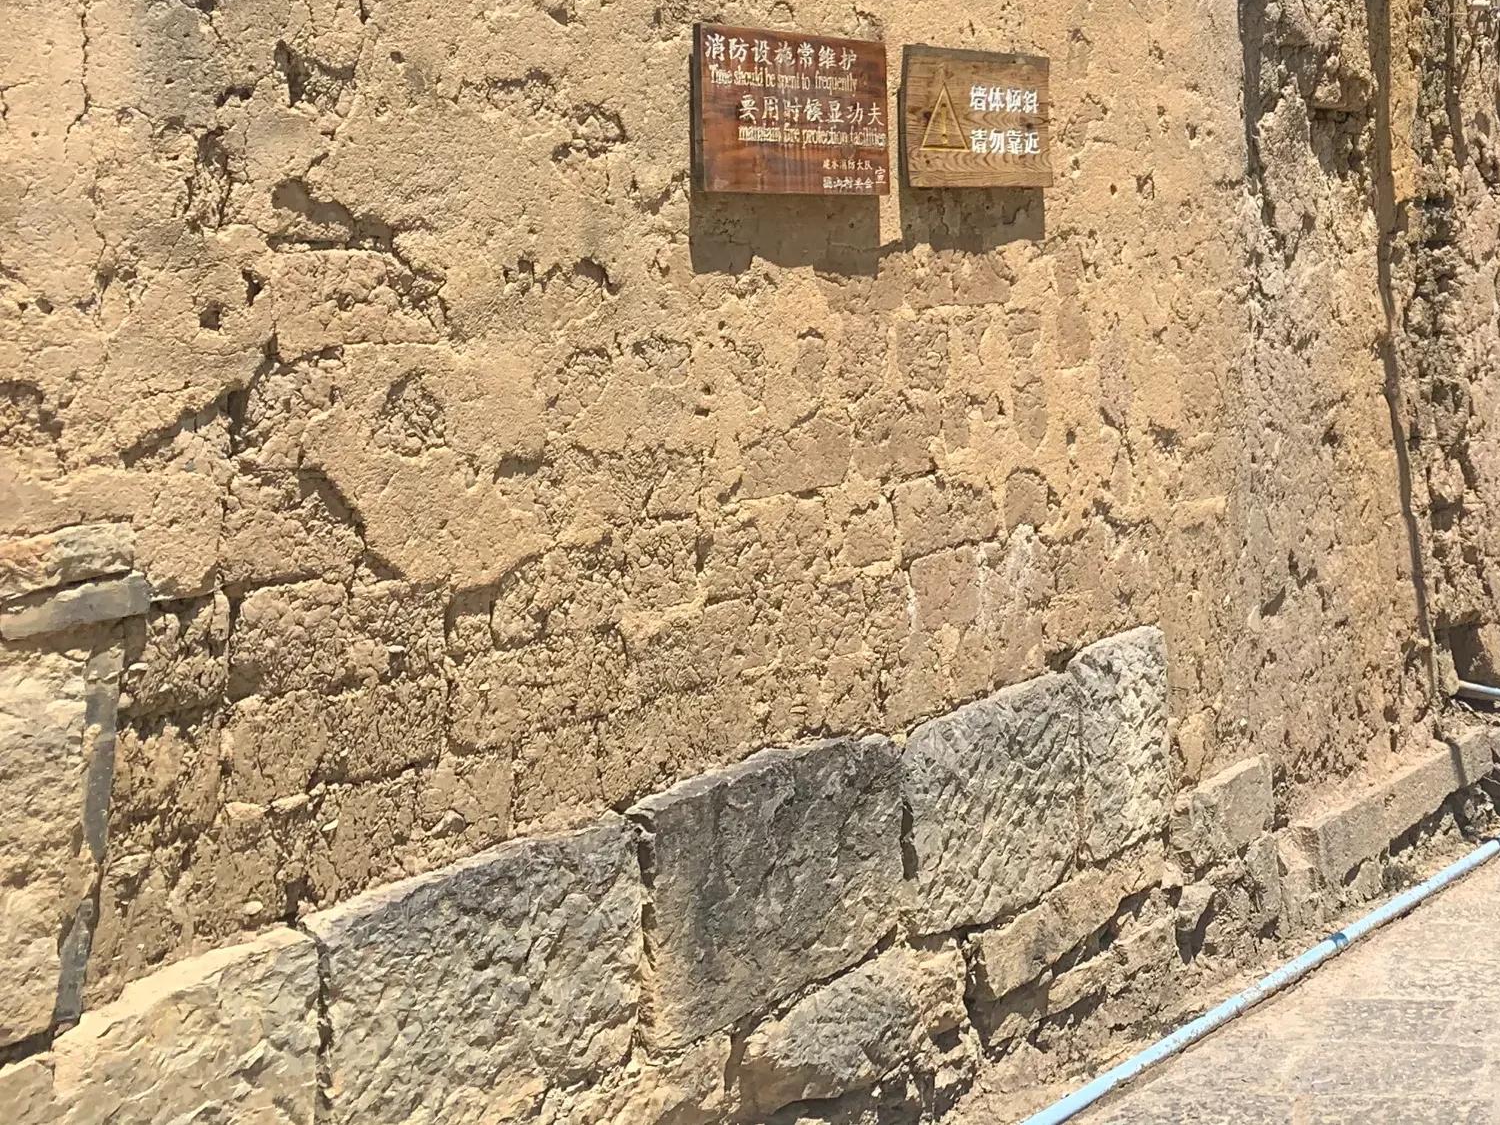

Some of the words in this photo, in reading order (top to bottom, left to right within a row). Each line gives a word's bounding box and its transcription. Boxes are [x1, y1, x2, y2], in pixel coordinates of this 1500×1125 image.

[705, 34, 857, 70] 消防设施常维护
[734, 65, 763, 87] should
[765, 68, 776, 87] be
[777, 72, 800, 93] spent
[802, 72, 811, 90] to
[815, 70, 857, 96] frequently
[739, 94, 885, 126] 要用时候显功夫
[969, 84, 1039, 113] 墙体倾斜
[738, 122, 781, 142] maintain
[783, 123, 799, 143] fire
[802, 126, 848, 148] protection
[850, 126, 886, 147] facilities
[970, 126, 1041, 154] 请勿靠近
